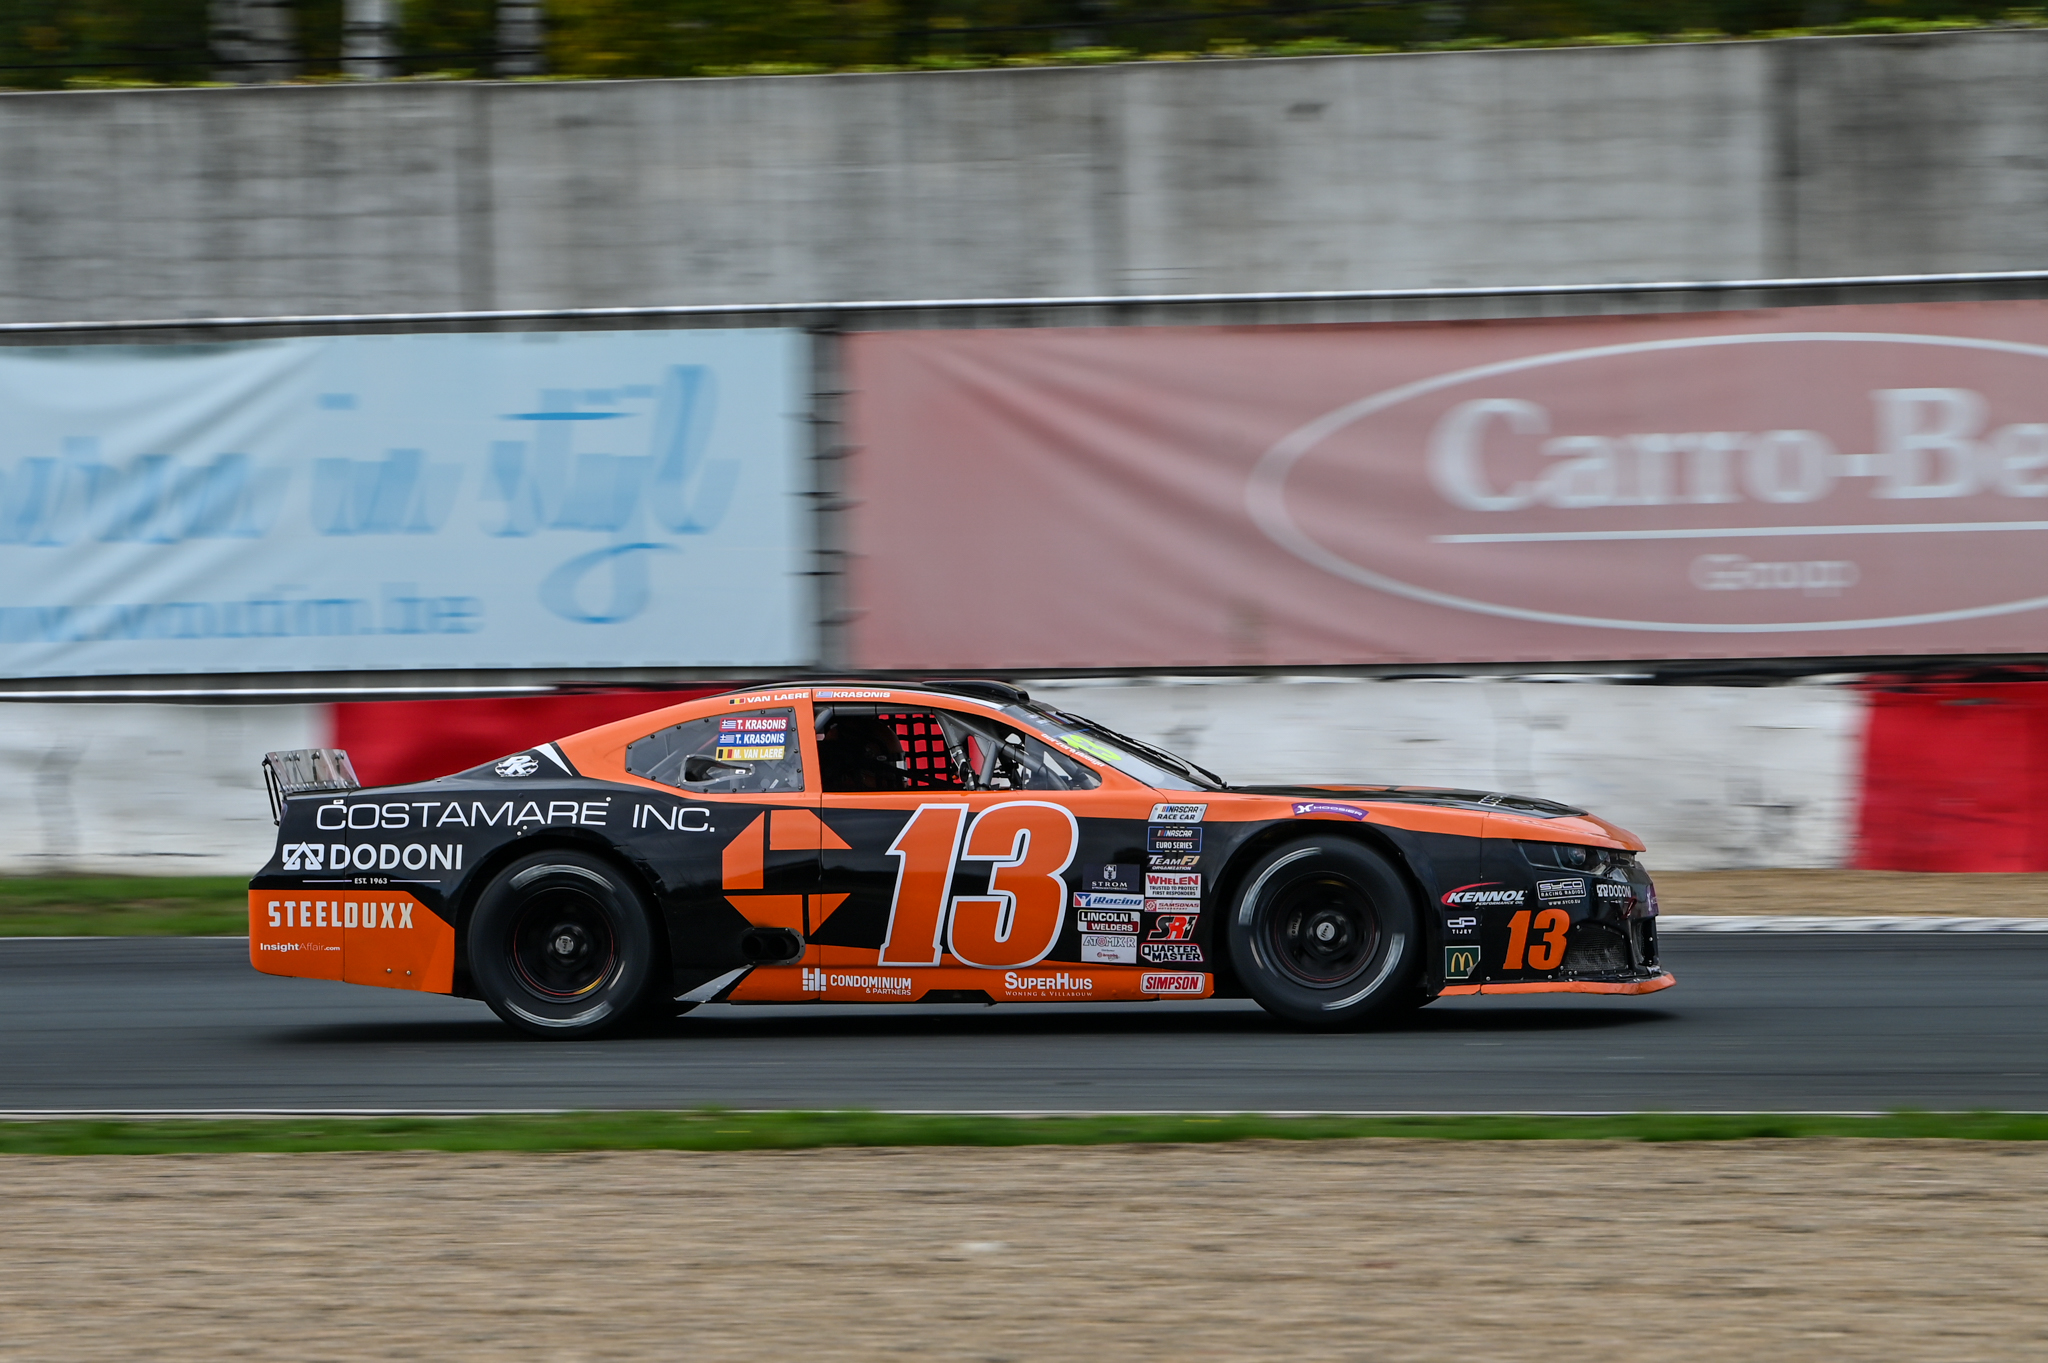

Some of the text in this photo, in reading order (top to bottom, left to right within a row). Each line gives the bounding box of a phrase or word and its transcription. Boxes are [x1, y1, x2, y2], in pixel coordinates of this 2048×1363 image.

[747, 692, 809, 703] VAN LAERE
[737, 719, 787, 729] T. KRASONIS
[736, 733, 785, 744] T. KRASONIS
[733, 748, 783, 759] M. VAN LAERE
[1313, 805, 1362, 816] HOOSIER
[316, 801, 715, 832] COSTAMARE INC.
[1165, 829, 1193, 837] NASCAR
[1156, 841, 1193, 849] EURO SERIES
[330, 843, 463, 870] DODONI
[369, 877, 388, 885] 1963
[877, 800, 1079, 970] 13
[1147, 874, 1199, 885] WHELEN
[1092, 896, 1142, 906] iRacing
[1447, 890, 1525, 903] KENNOL
[268, 901, 413, 928] STEELDUXX
[1081, 912, 1129, 922] LINCOLN
[1091, 923, 1133, 931] WELDERS
[1147, 915, 1198, 940] SRI
[1502, 908, 1570, 971] 13
[260, 942, 340, 952] InsightAffair.com
[1142, 945, 1198, 956] QUARTER
[1152, 953, 1201, 961] MASTER
[830, 974, 912, 989] CONDOMINIUM
[1146, 976, 1199, 990] SIMPSON
